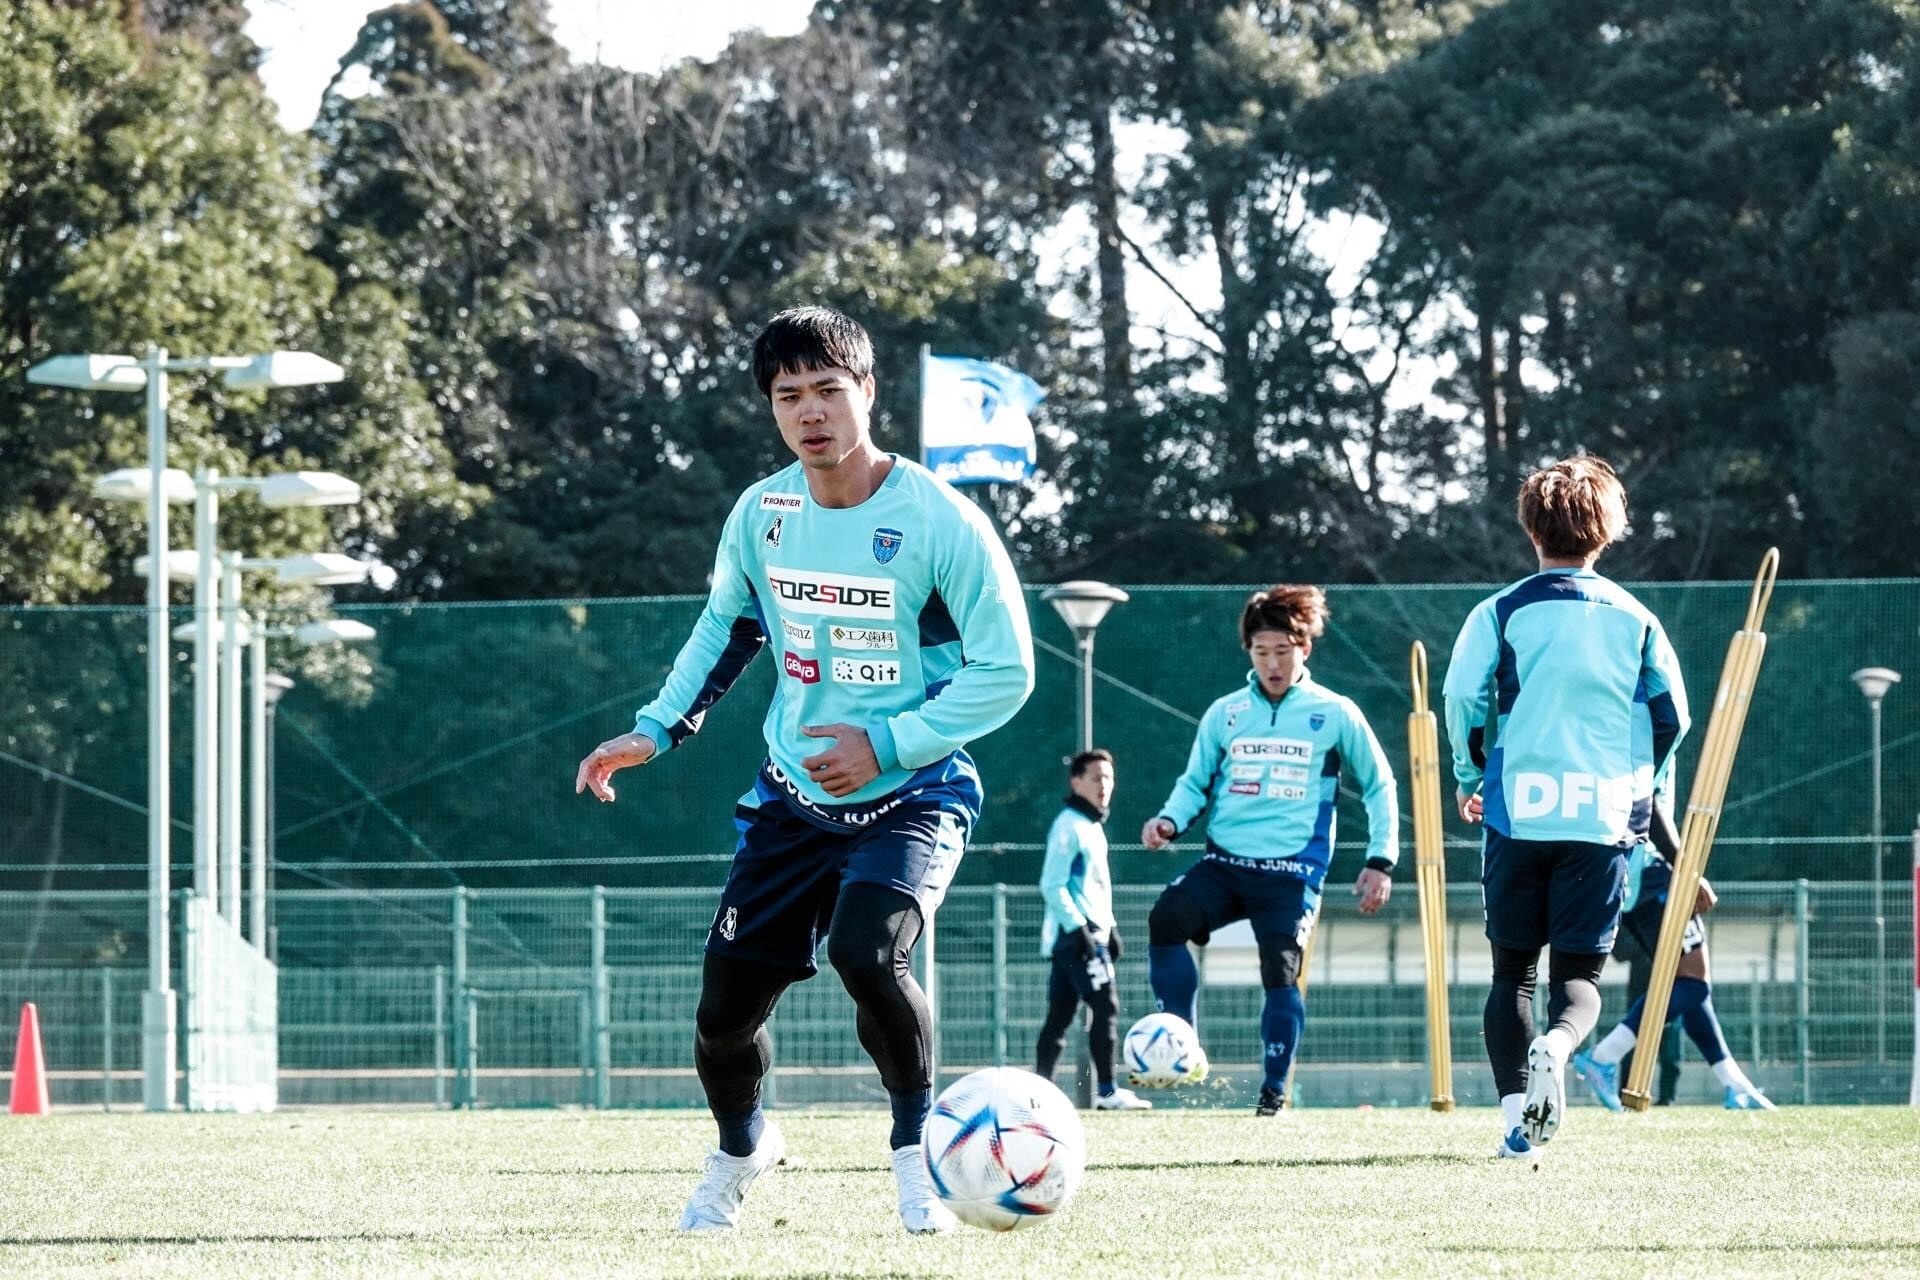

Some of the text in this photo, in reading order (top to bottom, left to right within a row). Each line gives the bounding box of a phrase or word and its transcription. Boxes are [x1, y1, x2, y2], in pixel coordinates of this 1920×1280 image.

[763, 497, 801, 507] FRONTIER
[769, 577, 891, 608] FORSIDE
[845, 630, 893, 643] エス歯科
[860, 664, 897, 682] Qit
